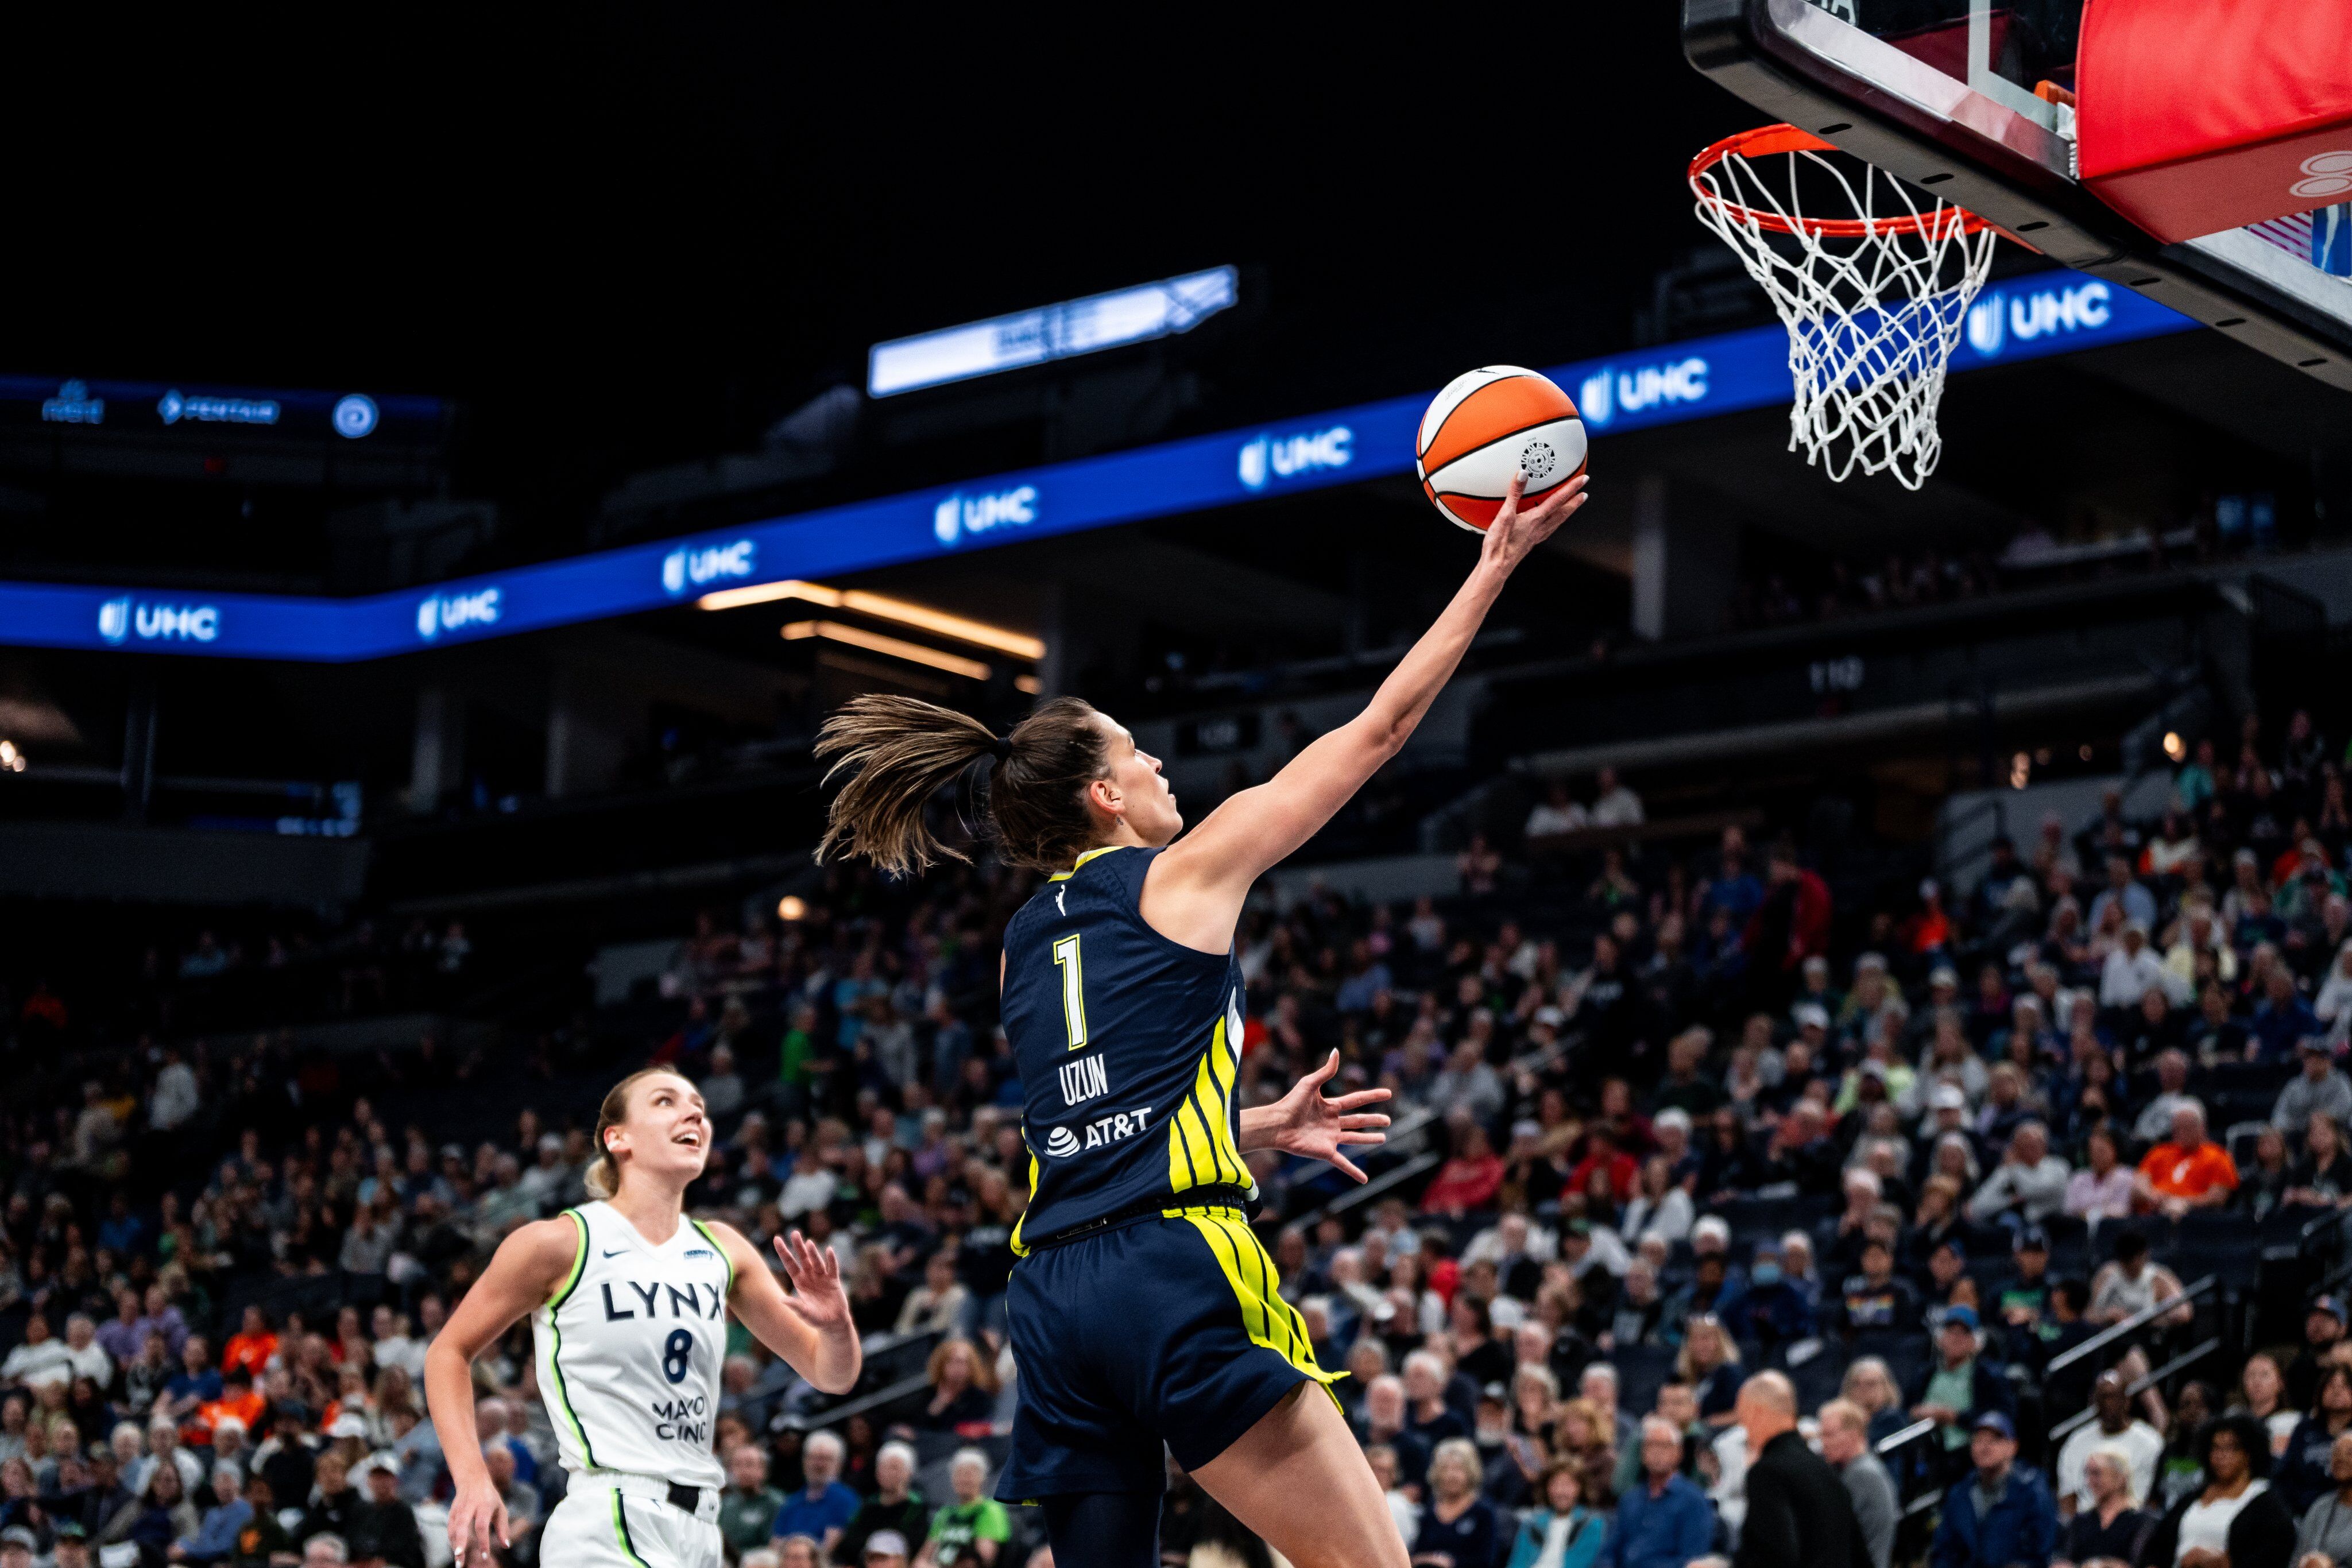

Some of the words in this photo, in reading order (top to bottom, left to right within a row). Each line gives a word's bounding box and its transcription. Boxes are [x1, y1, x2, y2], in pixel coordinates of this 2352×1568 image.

[2011, 281, 2110, 338] UHC
[1618, 357, 1708, 412] UHC
[1272, 426, 1351, 475] UHC
[964, 485, 1035, 532] UHC
[689, 539, 754, 584] UHC
[135, 603, 219, 642] UHC
[1053, 934, 1087, 1051] 1
[1059, 1054, 1108, 1106] UZUN
[1085, 1107, 1151, 1150] AT&T
[601, 1281, 724, 1323] LYNX
[662, 1329, 693, 1384] 8
